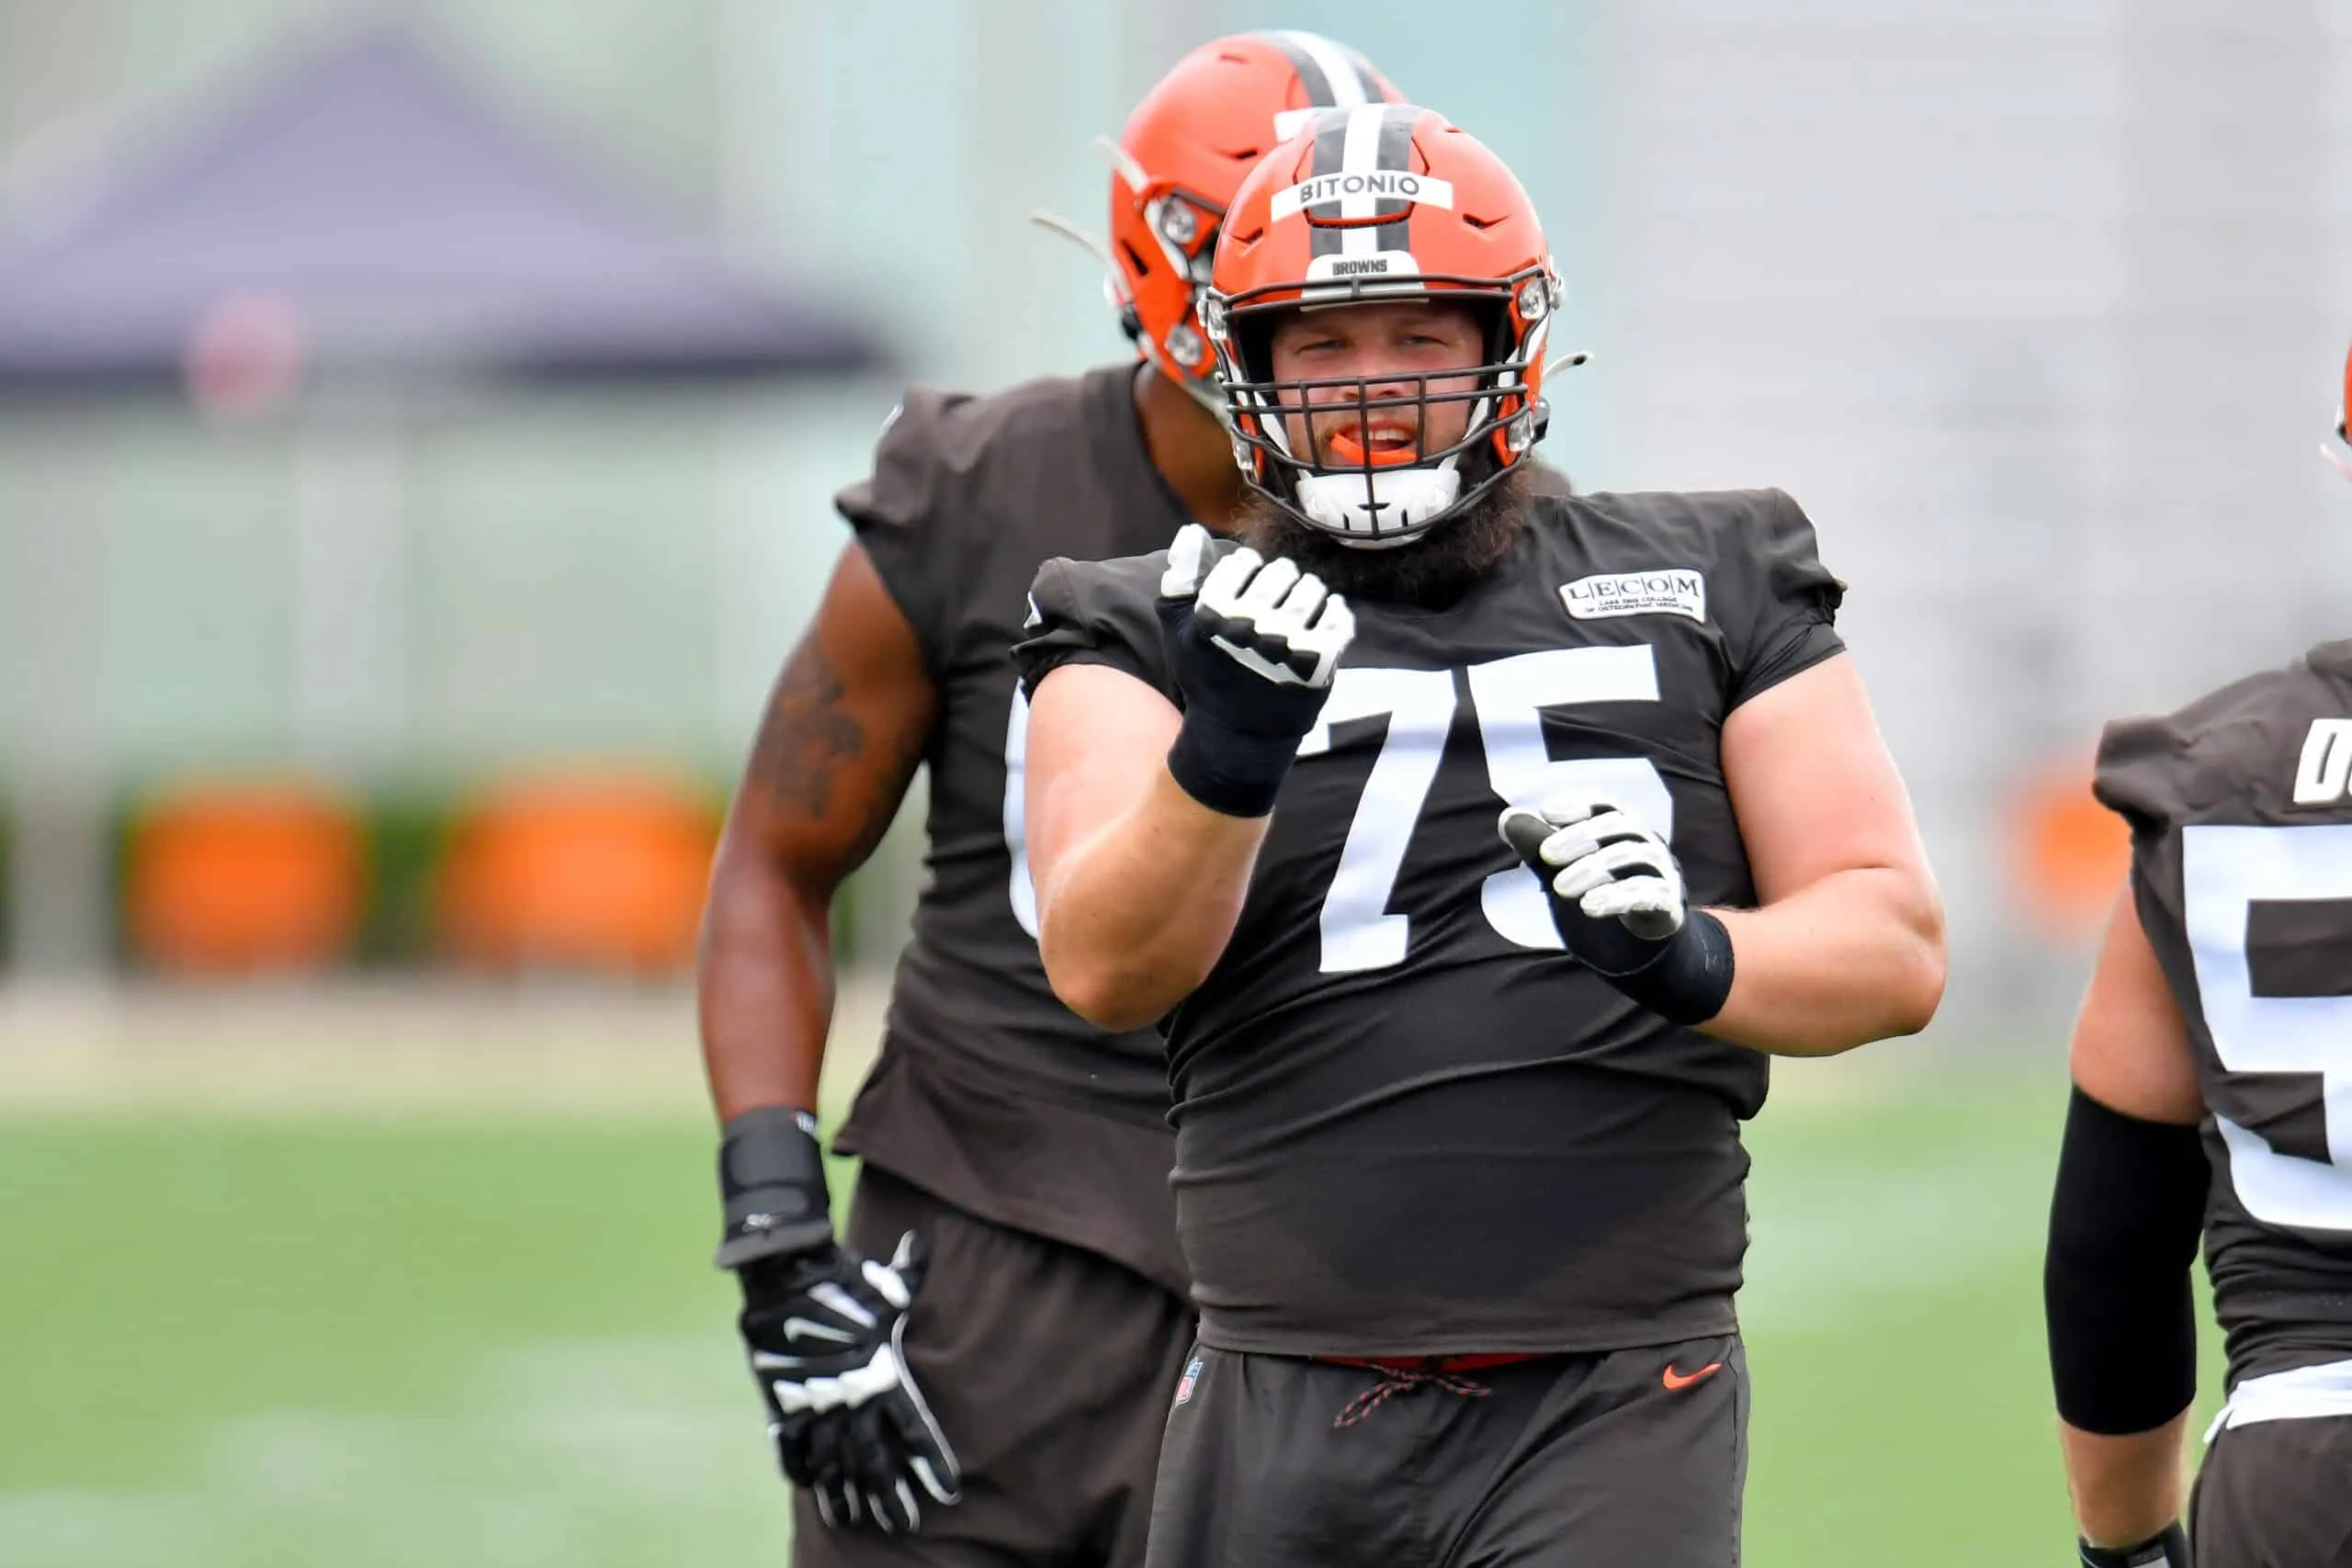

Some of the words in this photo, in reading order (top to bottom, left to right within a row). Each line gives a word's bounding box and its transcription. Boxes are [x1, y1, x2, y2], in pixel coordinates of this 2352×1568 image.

[1299, 174, 1420, 204] BITONIO
[1332, 258, 1387, 276] BROWNS
[1296, 644, 1674, 974] 75
